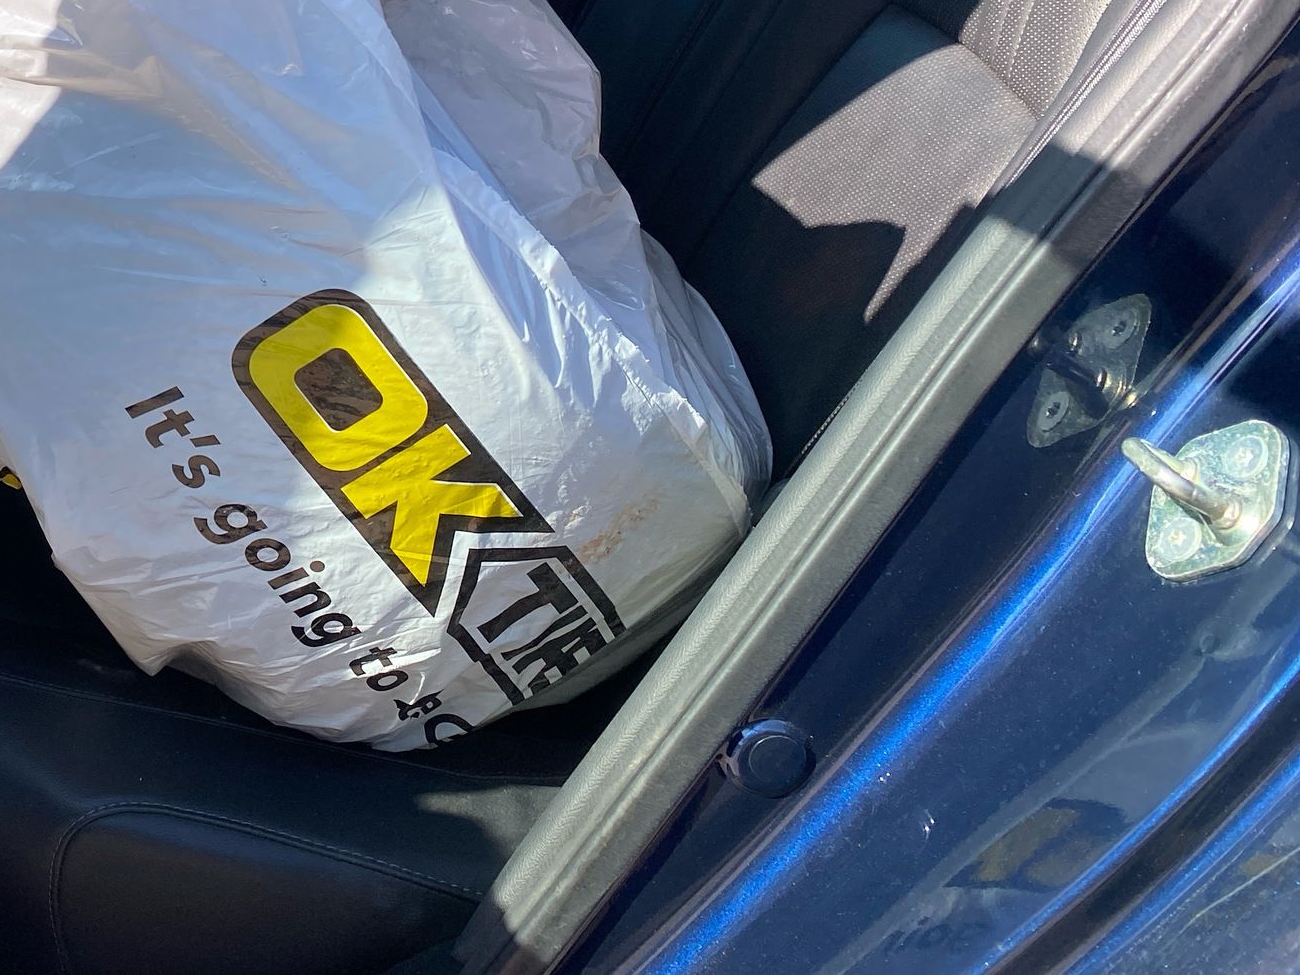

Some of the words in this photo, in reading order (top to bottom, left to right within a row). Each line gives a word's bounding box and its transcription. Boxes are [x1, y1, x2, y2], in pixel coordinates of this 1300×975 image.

[124, 385, 222, 489] It's
[193, 502, 362, 649] going
[348, 646, 409, 692] to
[247, 302, 524, 588] OK
